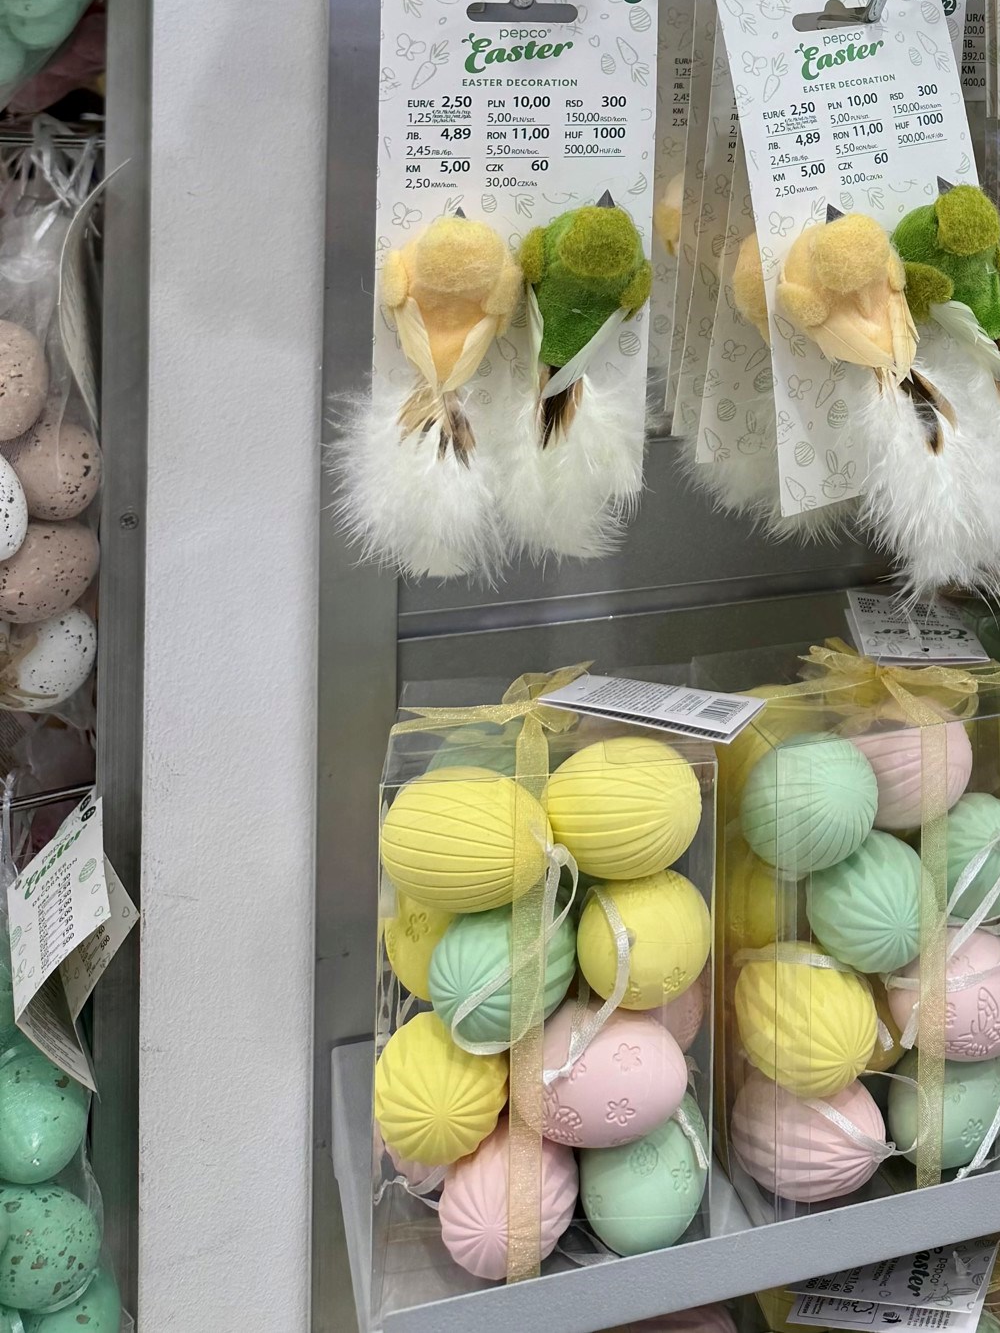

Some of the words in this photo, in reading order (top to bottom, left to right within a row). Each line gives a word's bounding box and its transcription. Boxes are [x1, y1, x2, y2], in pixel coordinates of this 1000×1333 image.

[500, 28, 548, 40] pepco
[822, 31, 861, 46] pepco
[462, 32, 573, 74] Easter
[794, 40, 884, 80] Easter
[462, 78, 502, 86] EASTER
[506, 78, 578, 86] DECORATION
[803, 82, 836, 94] EASTER
[838, 74, 896, 89] DECORATION
[918, 84, 938, 97] 300
[408, 98, 435, 108] EUR/€
[442, 96, 472, 109] 2,50
[488, 99, 505, 108] PLN
[513, 96, 550, 109] 10,00
[566, 99, 583, 108] RSD
[601, 96, 626, 108] 300
[847, 92, 878, 107] 10,00
[790, 102, 816, 116] 2,50
[408, 112, 432, 124] 1,25
[488, 112, 512, 124] 5,00
[566, 112, 600, 123] 150,00
[916, 113, 943, 127] 1000
[406, 130, 422, 140] ЛВ.
[440, 128, 471, 141] 4,89
[487, 131, 507, 140] RON
[512, 128, 550, 141] 11,00
[565, 130, 582, 138] HUF
[593, 127, 625, 138] 1000
[852, 122, 883, 138] 11,00
[796, 132, 820, 146] 4,89
[406, 145, 431, 156] 2,45
[486, 144, 510, 156] 5,50
[564, 144, 599, 155] 500,00
[874, 152, 888, 165] 60
[406, 164, 421, 173] KM
[440, 160, 470, 174] 5,00
[486, 163, 504, 172] CZK
[531, 160, 548, 172] 60
[800, 162, 825, 178] 5,00
[406, 178, 430, 190] 2,50
[486, 177, 517, 188] 30,00
[22, 824, 87, 900] Easter
